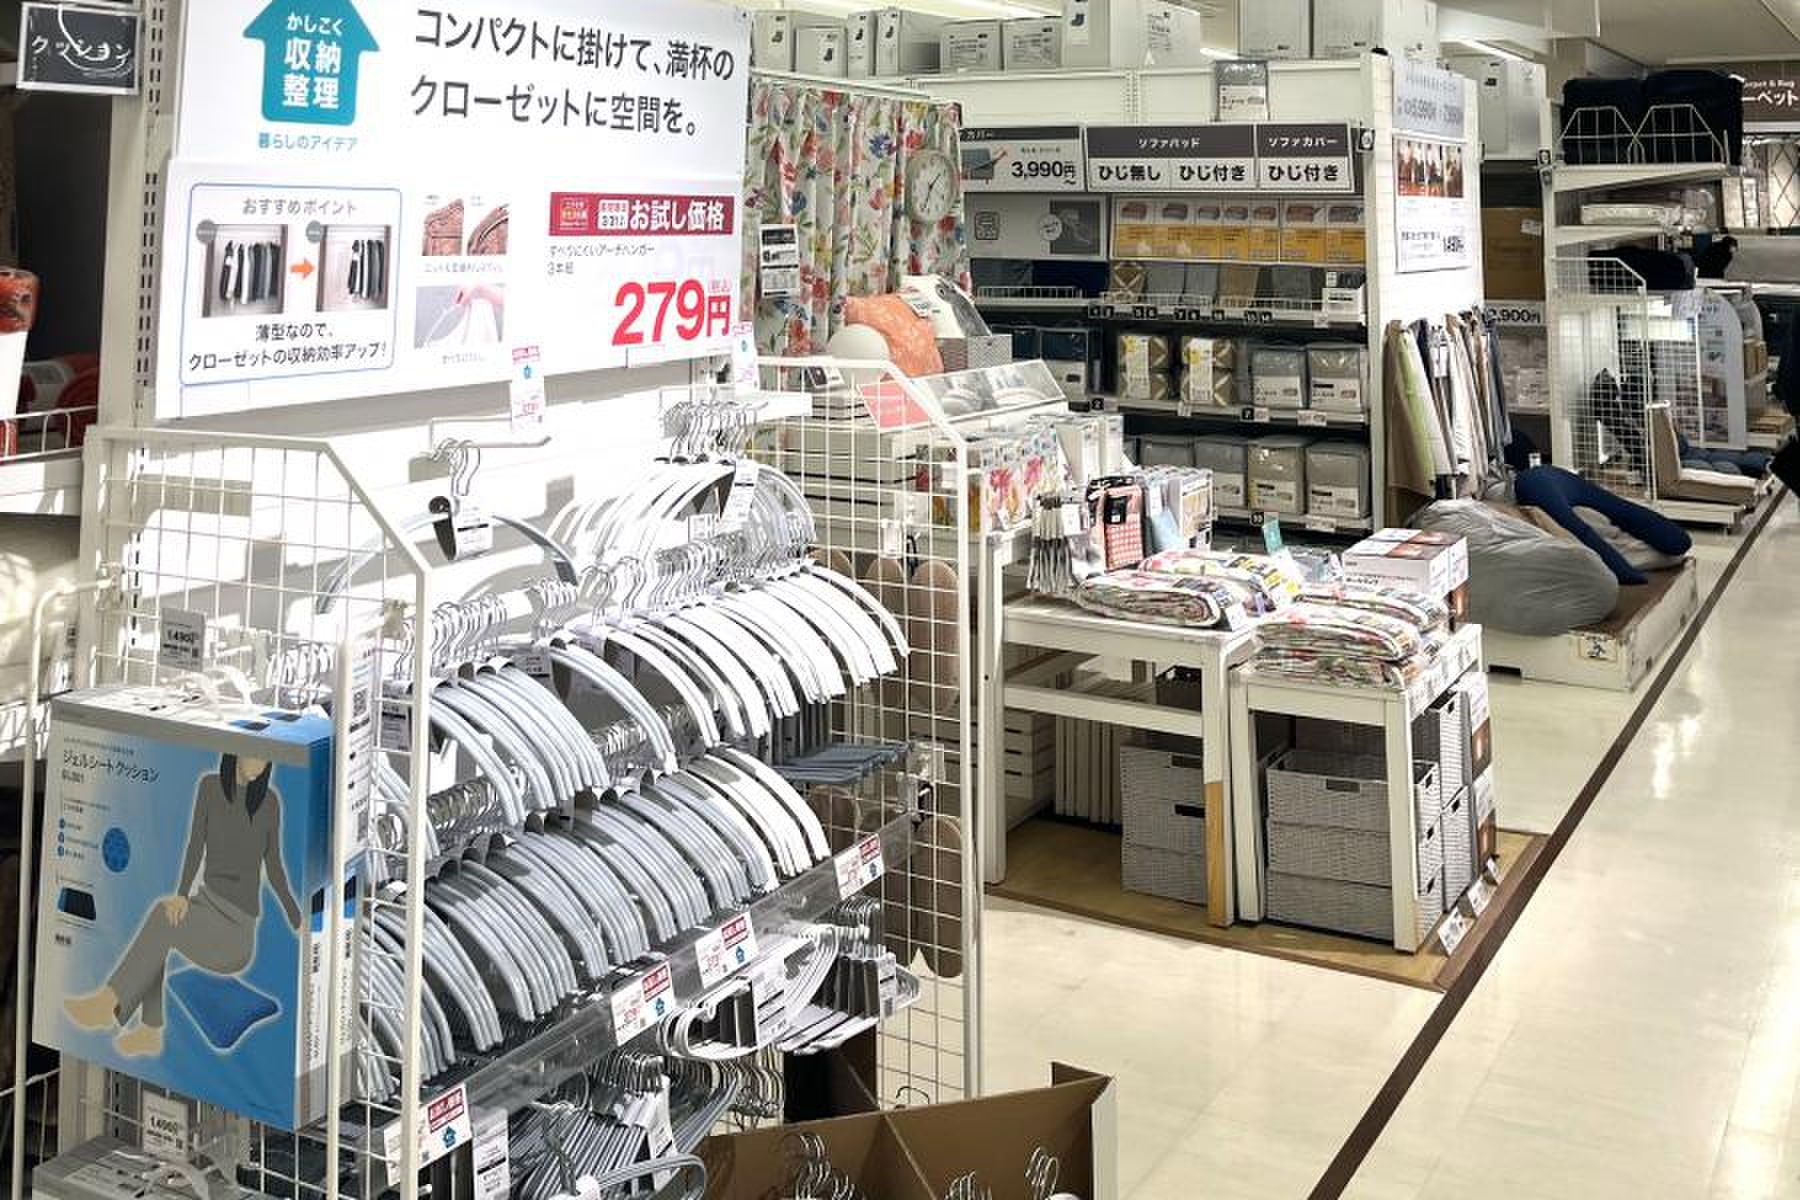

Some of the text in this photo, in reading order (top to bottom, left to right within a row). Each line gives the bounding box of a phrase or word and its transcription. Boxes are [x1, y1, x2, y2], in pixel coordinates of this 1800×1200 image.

[287, 12, 343, 36] かしこく
[284, 38, 341, 73] 収納
[415, 8, 734, 81] コンパクトに掛けて、満杯の
[283, 73, 339, 109] 整理
[1741, 90, 1799, 106] ーペット
[411, 75, 697, 136] クローゼットに空間を。
[258, 131, 357, 151] 暮らしのアイデア
[1098, 161, 1246, 182] ひじ無し ひじ付き
[1268, 162, 1339, 182] ひじ付き
[243, 198, 356, 216] おすすめポイント
[630, 200, 725, 231] お試し価格
[256, 322, 334, 342] 薄型なので、
